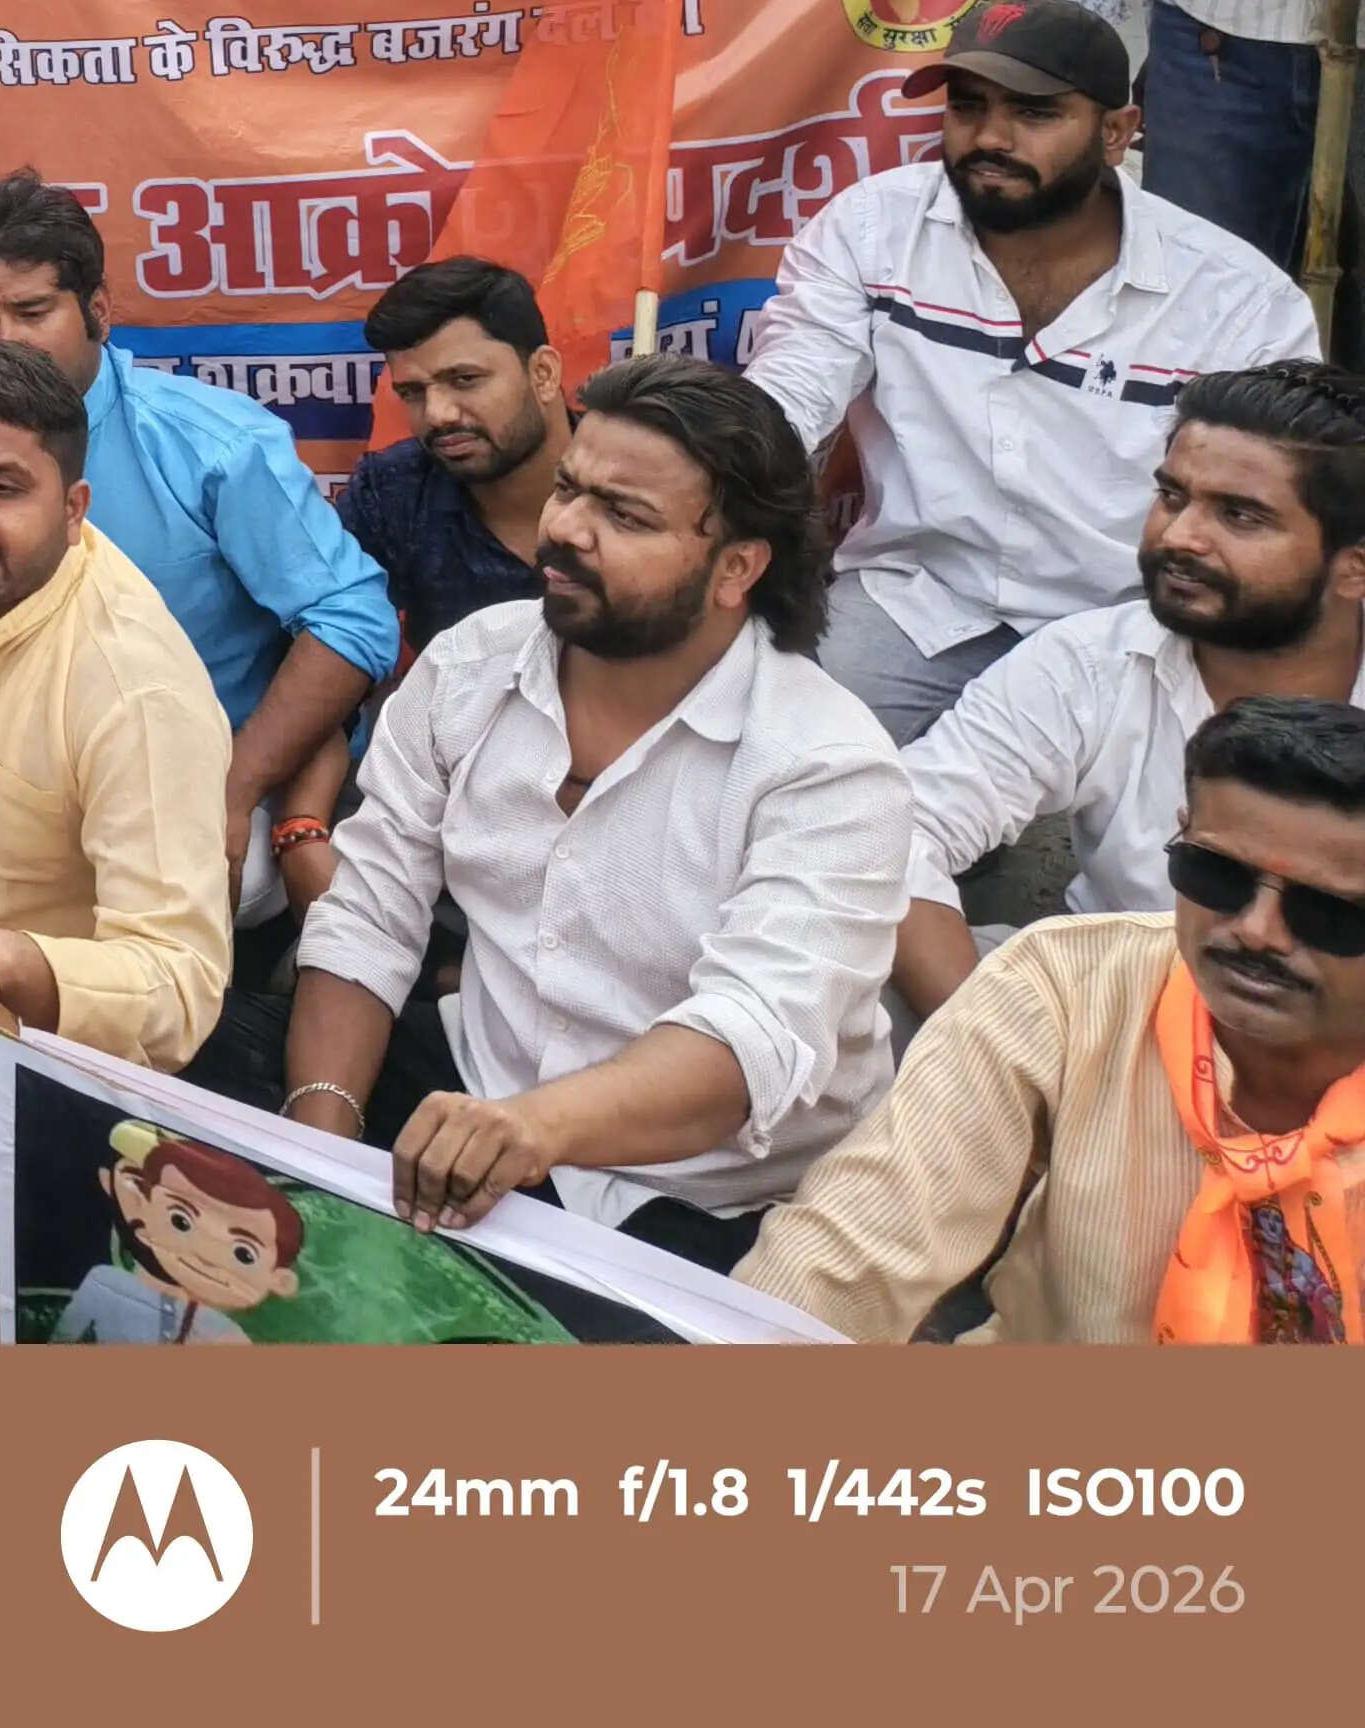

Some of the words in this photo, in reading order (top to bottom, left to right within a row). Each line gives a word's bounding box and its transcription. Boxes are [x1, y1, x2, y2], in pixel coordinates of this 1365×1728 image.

[143, 19, 198, 81] के
[205, 15, 362, 76] विरुद्ध
[366, 0, 523, 65] बजरंग
[883, 28, 938, 50] सुरक्षा
